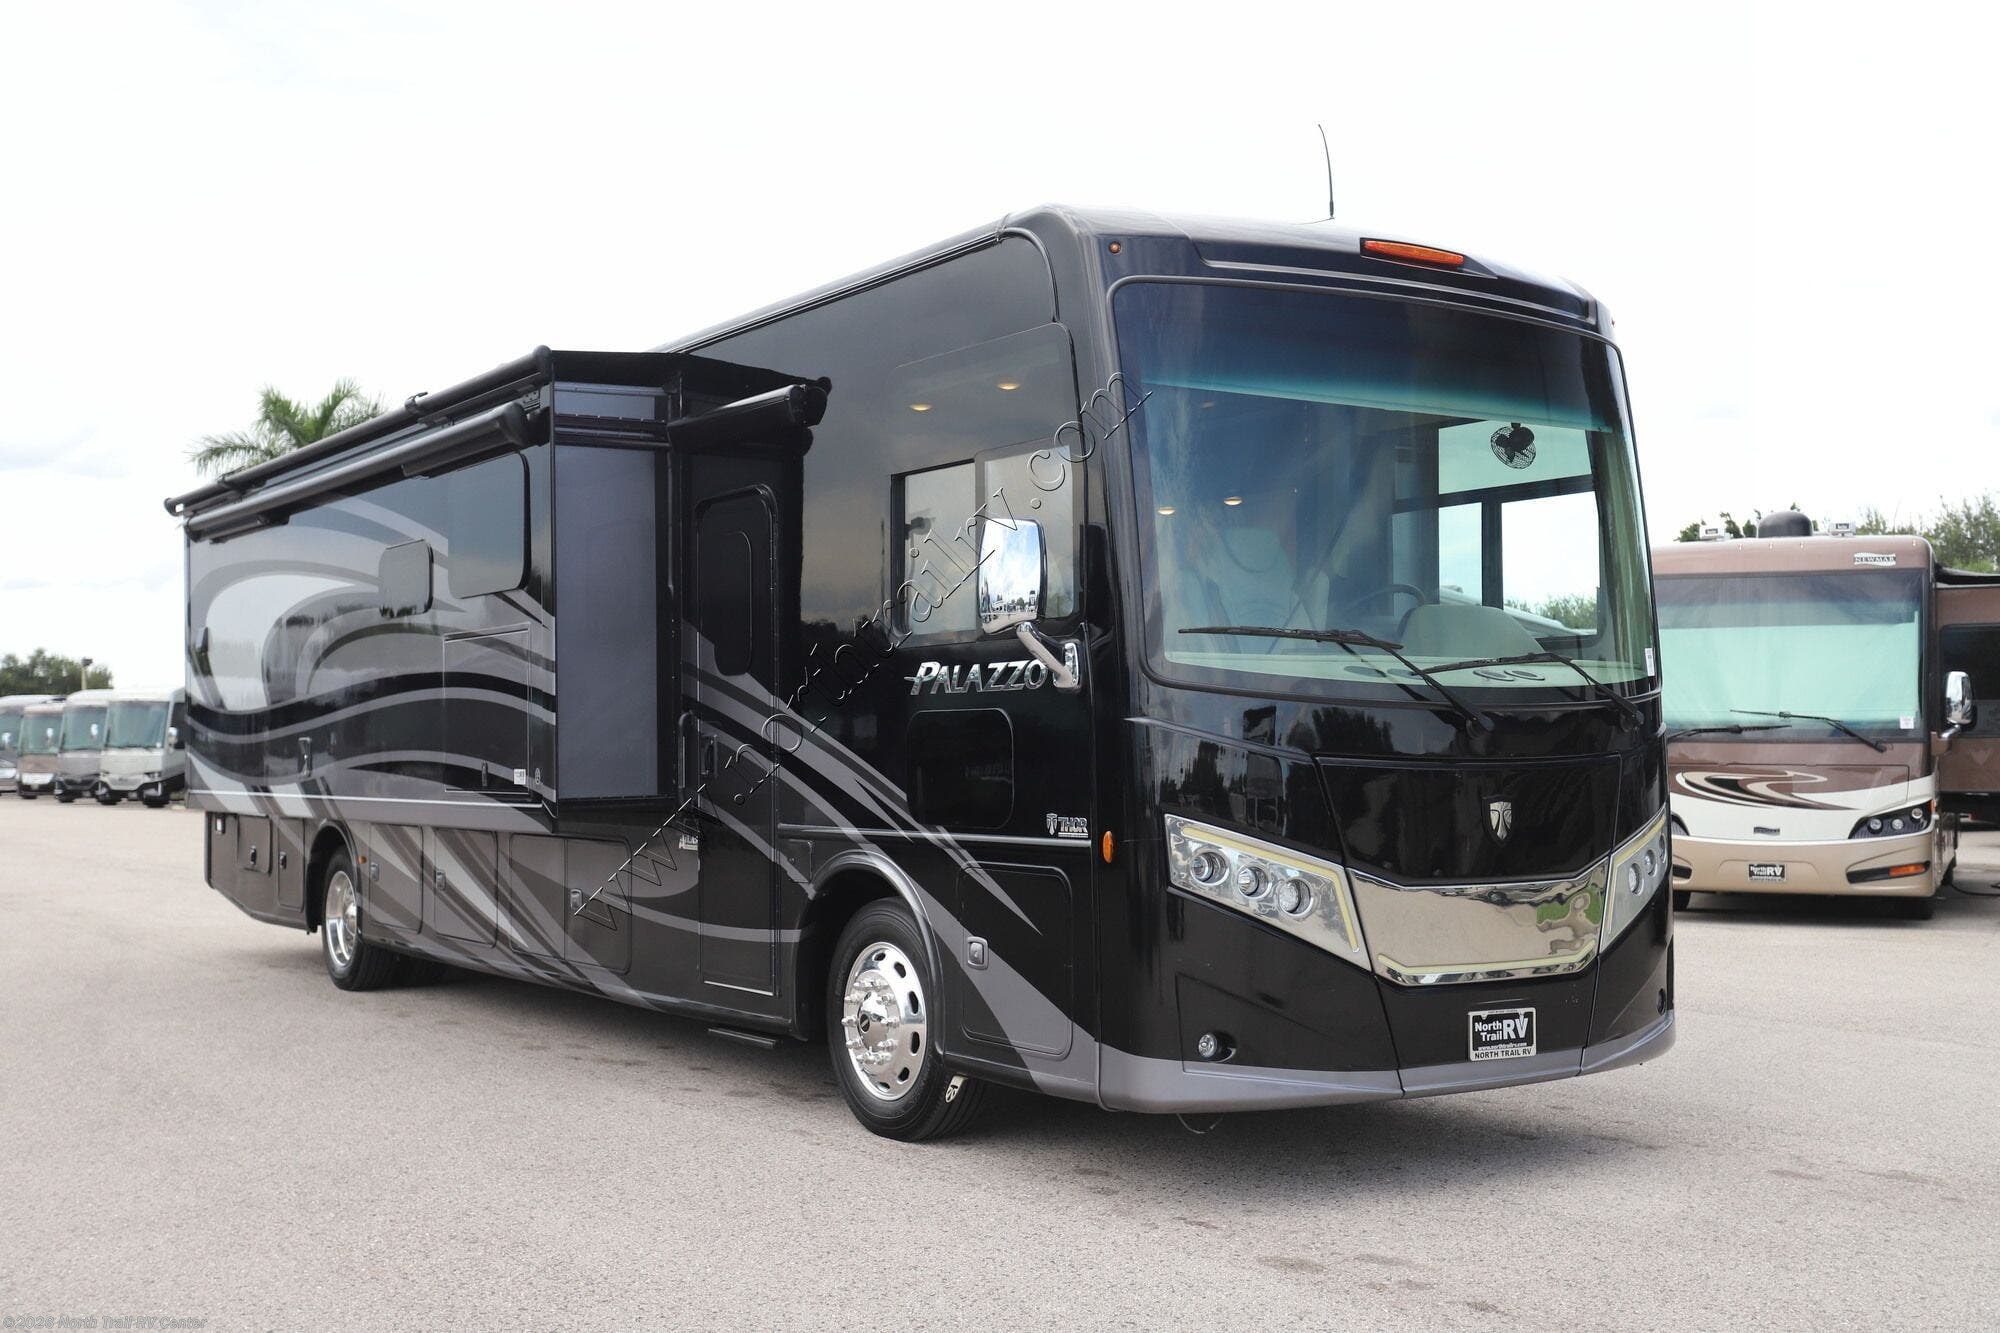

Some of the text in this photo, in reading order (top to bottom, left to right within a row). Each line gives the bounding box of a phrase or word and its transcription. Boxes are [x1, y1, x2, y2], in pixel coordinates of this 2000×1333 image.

[904, 660, 1049, 696] PALAZZO
[1058, 816, 1088, 833] THOR
[1767, 866, 1783, 876] RV
[1475, 1021, 1502, 1032] North
[1503, 1018, 1529, 1040] RV
[1480, 1031, 1502, 1042] Trail
[1475, 1051, 1499, 1059] NORTH
[1522, 1048, 1532, 1056] RV
